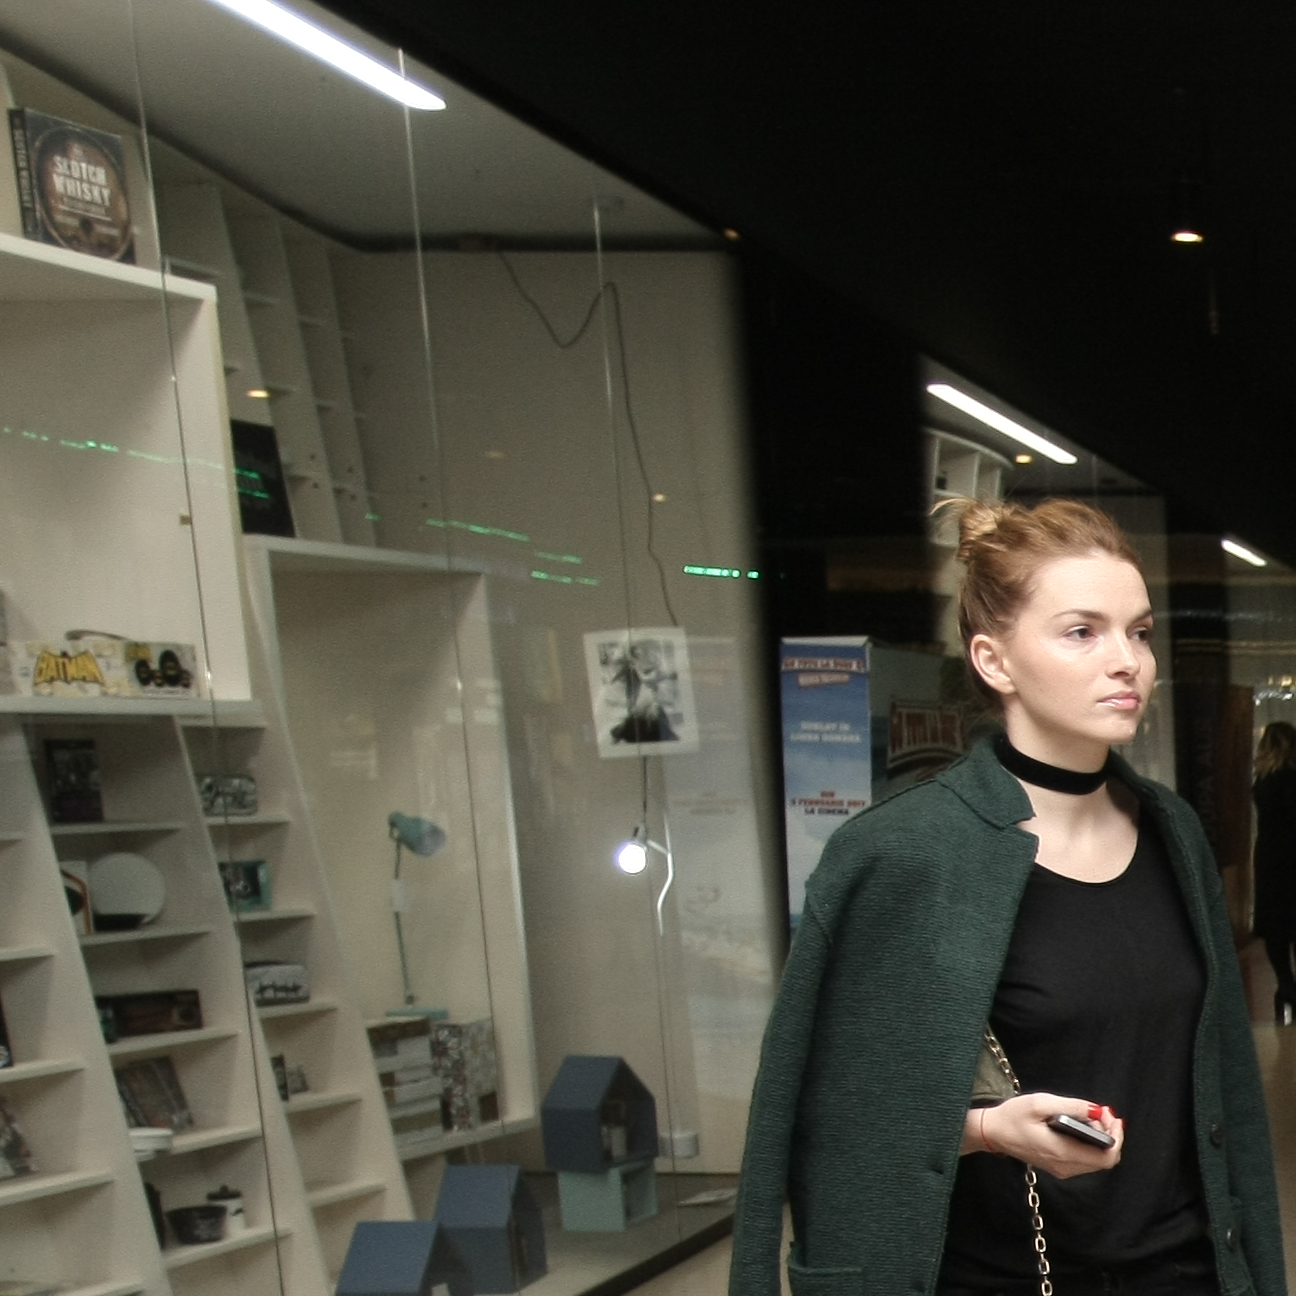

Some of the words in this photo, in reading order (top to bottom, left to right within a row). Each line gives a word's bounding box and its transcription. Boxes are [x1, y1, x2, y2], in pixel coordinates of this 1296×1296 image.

[53, 154, 107, 186] SCOTCH
[52, 173, 112, 208] WHISKY
[33, 650, 105, 687] BATMAN
